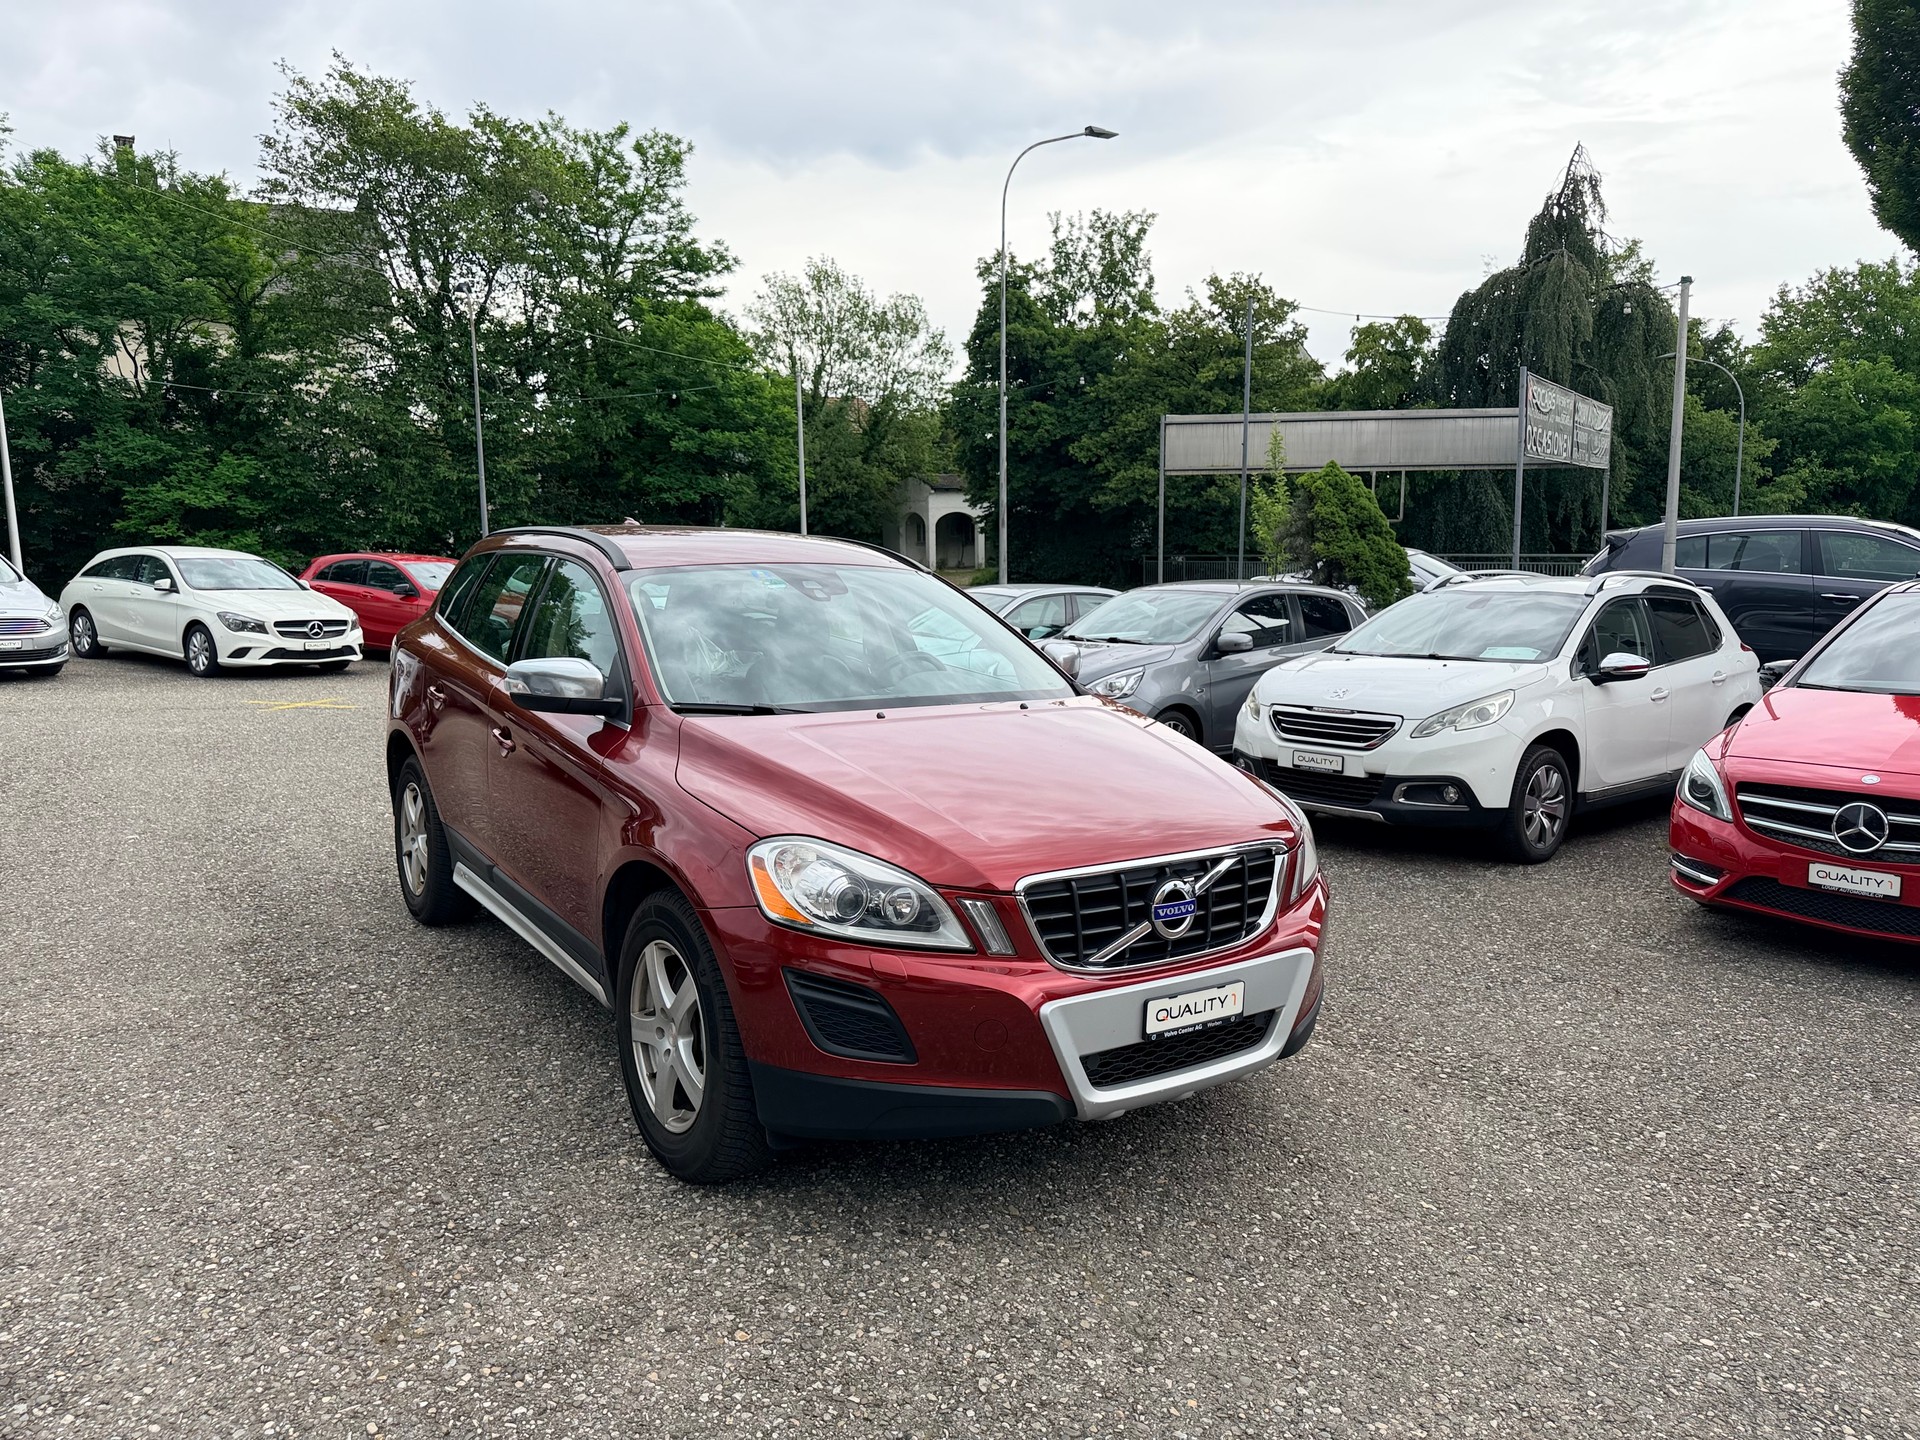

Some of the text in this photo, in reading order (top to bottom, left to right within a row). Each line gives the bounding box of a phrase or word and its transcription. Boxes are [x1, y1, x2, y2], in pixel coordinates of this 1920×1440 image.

[1526, 424, 1571, 457] OCCASIONEN
[1297, 755, 1334, 765] QUALITY
[1816, 870, 1893, 890] QUALITY 1
[1157, 903, 1194, 917] VOLVO
[1155, 993, 1237, 1022] QUALITY 1
[1163, 1029, 1178, 1038] Volvo
[1178, 1026, 1195, 1035] Center
[1194, 1023, 1203, 1031] AG
